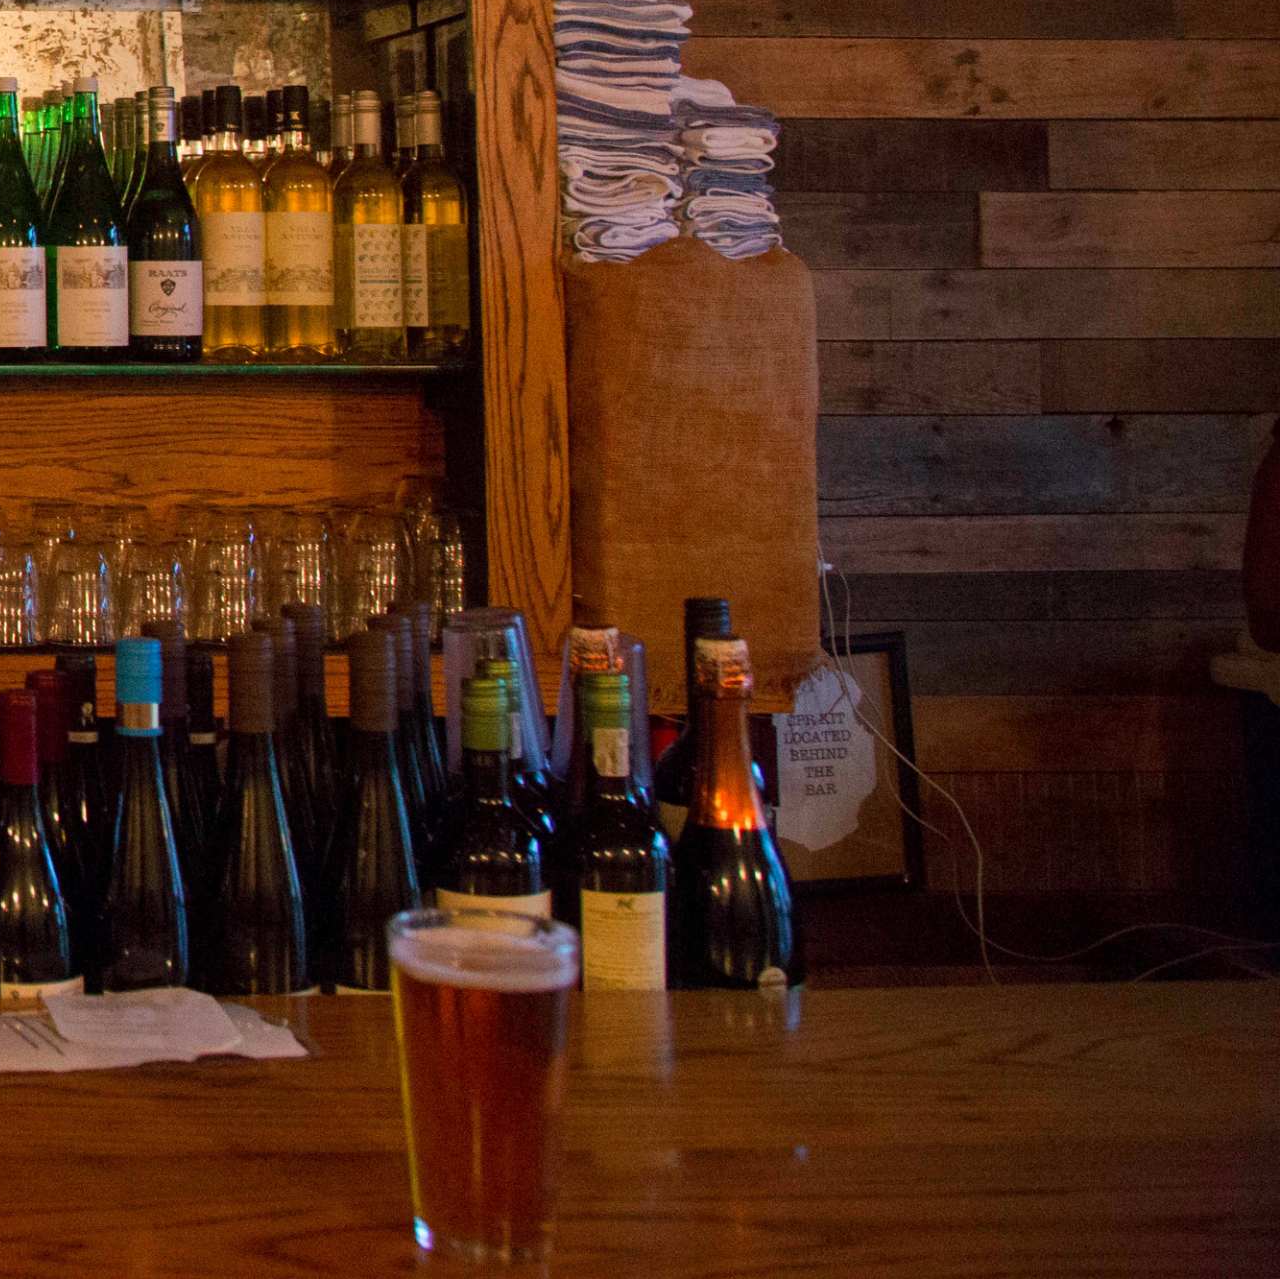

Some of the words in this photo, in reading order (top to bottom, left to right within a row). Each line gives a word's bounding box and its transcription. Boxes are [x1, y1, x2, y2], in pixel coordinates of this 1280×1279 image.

[784, 730, 851, 744] LOCATED
[790, 747, 848, 761] BEHIND
[804, 765, 834, 778] THE
[805, 783, 838, 797] BAR
